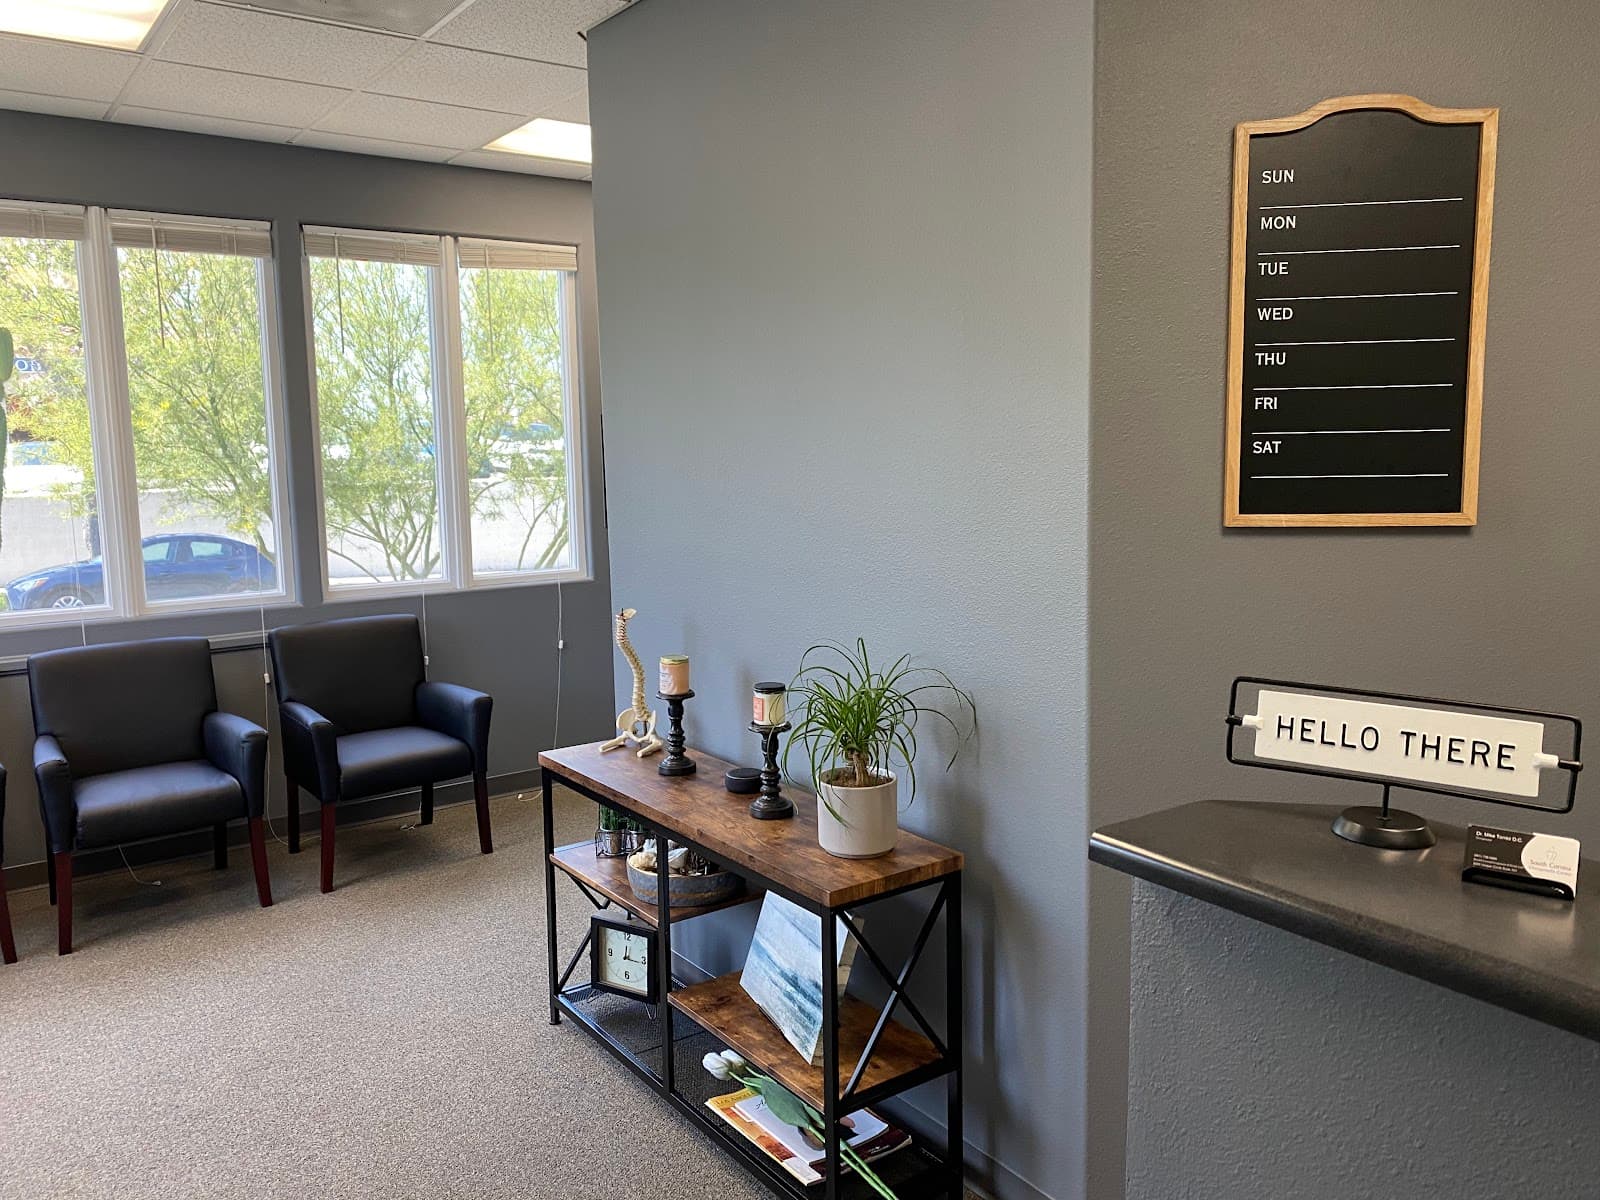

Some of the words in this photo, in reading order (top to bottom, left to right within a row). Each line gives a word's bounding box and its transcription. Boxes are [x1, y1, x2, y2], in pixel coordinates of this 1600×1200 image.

[1262, 169, 1294, 183] SUN
[1261, 216, 1296, 230] MON
[1258, 262, 1288, 275] TUE
[1258, 308, 1293, 320] WED
[1255, 352, 1286, 365] THU
[1255, 397, 1277, 409] FRI
[1253, 441, 1281, 453] SAT
[1276, 715, 1379, 751] HELLO
[1400, 730, 1516, 770] THERE
[624, 933, 631, 941] 12
[607, 948, 613, 956] 9
[641, 956, 647, 965] 3
[624, 971, 630, 980] 6
